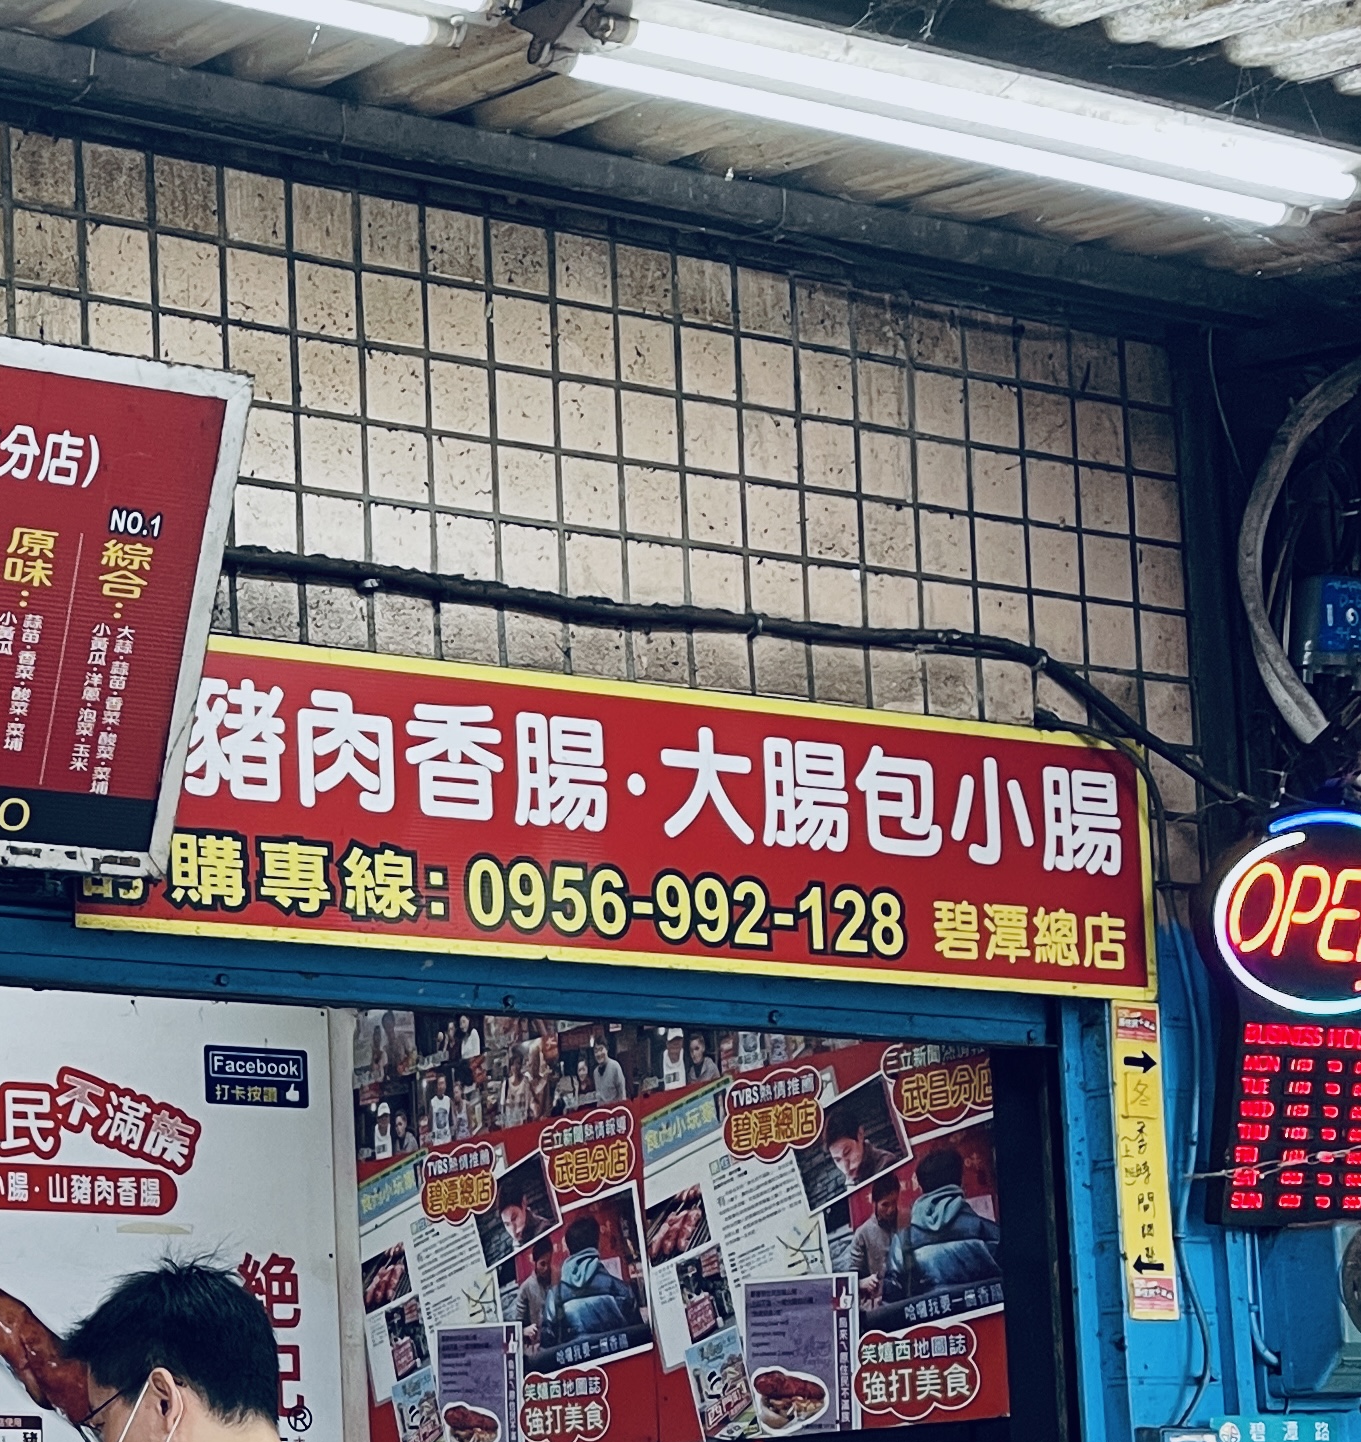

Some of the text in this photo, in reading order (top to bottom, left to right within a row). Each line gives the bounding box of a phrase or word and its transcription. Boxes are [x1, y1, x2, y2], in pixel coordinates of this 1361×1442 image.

[110, 508, 162, 537] NO.1
[933, 900, 1127, 971] 碧潭總店
[213, 1056, 298, 1076] Facebook
[731, 1099, 818, 1151] 碧潭總店
[554, 1140, 628, 1188] 武昌分店
[427, 1171, 491, 1214] 碧潭總店
[862, 1367, 971, 1403] 強打美食
[525, 1401, 604, 1436] 強打美食
